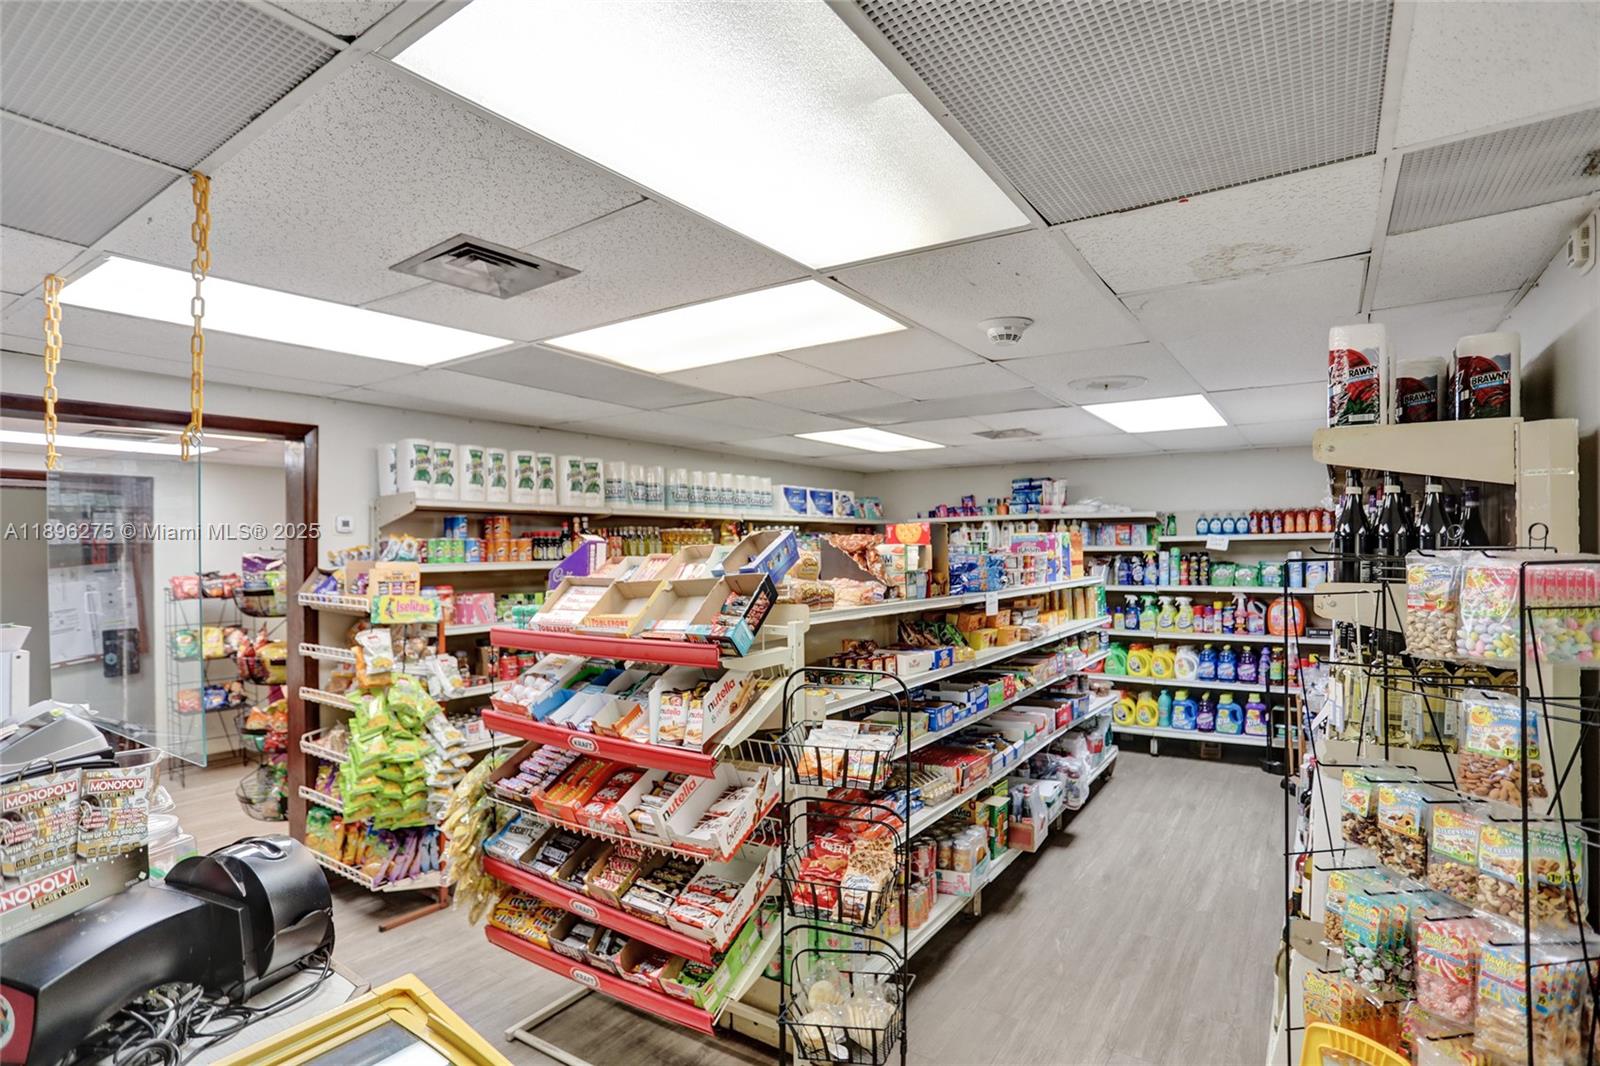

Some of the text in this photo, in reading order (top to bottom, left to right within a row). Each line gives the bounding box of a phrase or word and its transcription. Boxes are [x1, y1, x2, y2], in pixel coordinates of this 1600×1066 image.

[1471, 371, 1510, 386] BRAWNY
[1404, 391, 1436, 404] BRAWNY
[591, 618, 629, 628] TOBLERONE
[706, 678, 736, 712] nutella
[574, 740, 594, 751] KRAFT
[90, 779, 144, 791] MONOPOLY
[6, 781, 76, 810] MONOPOLY
[662, 779, 697, 822] nutella
[575, 903, 594, 915] KRAFT
[575, 972, 595, 984] KRAFT
